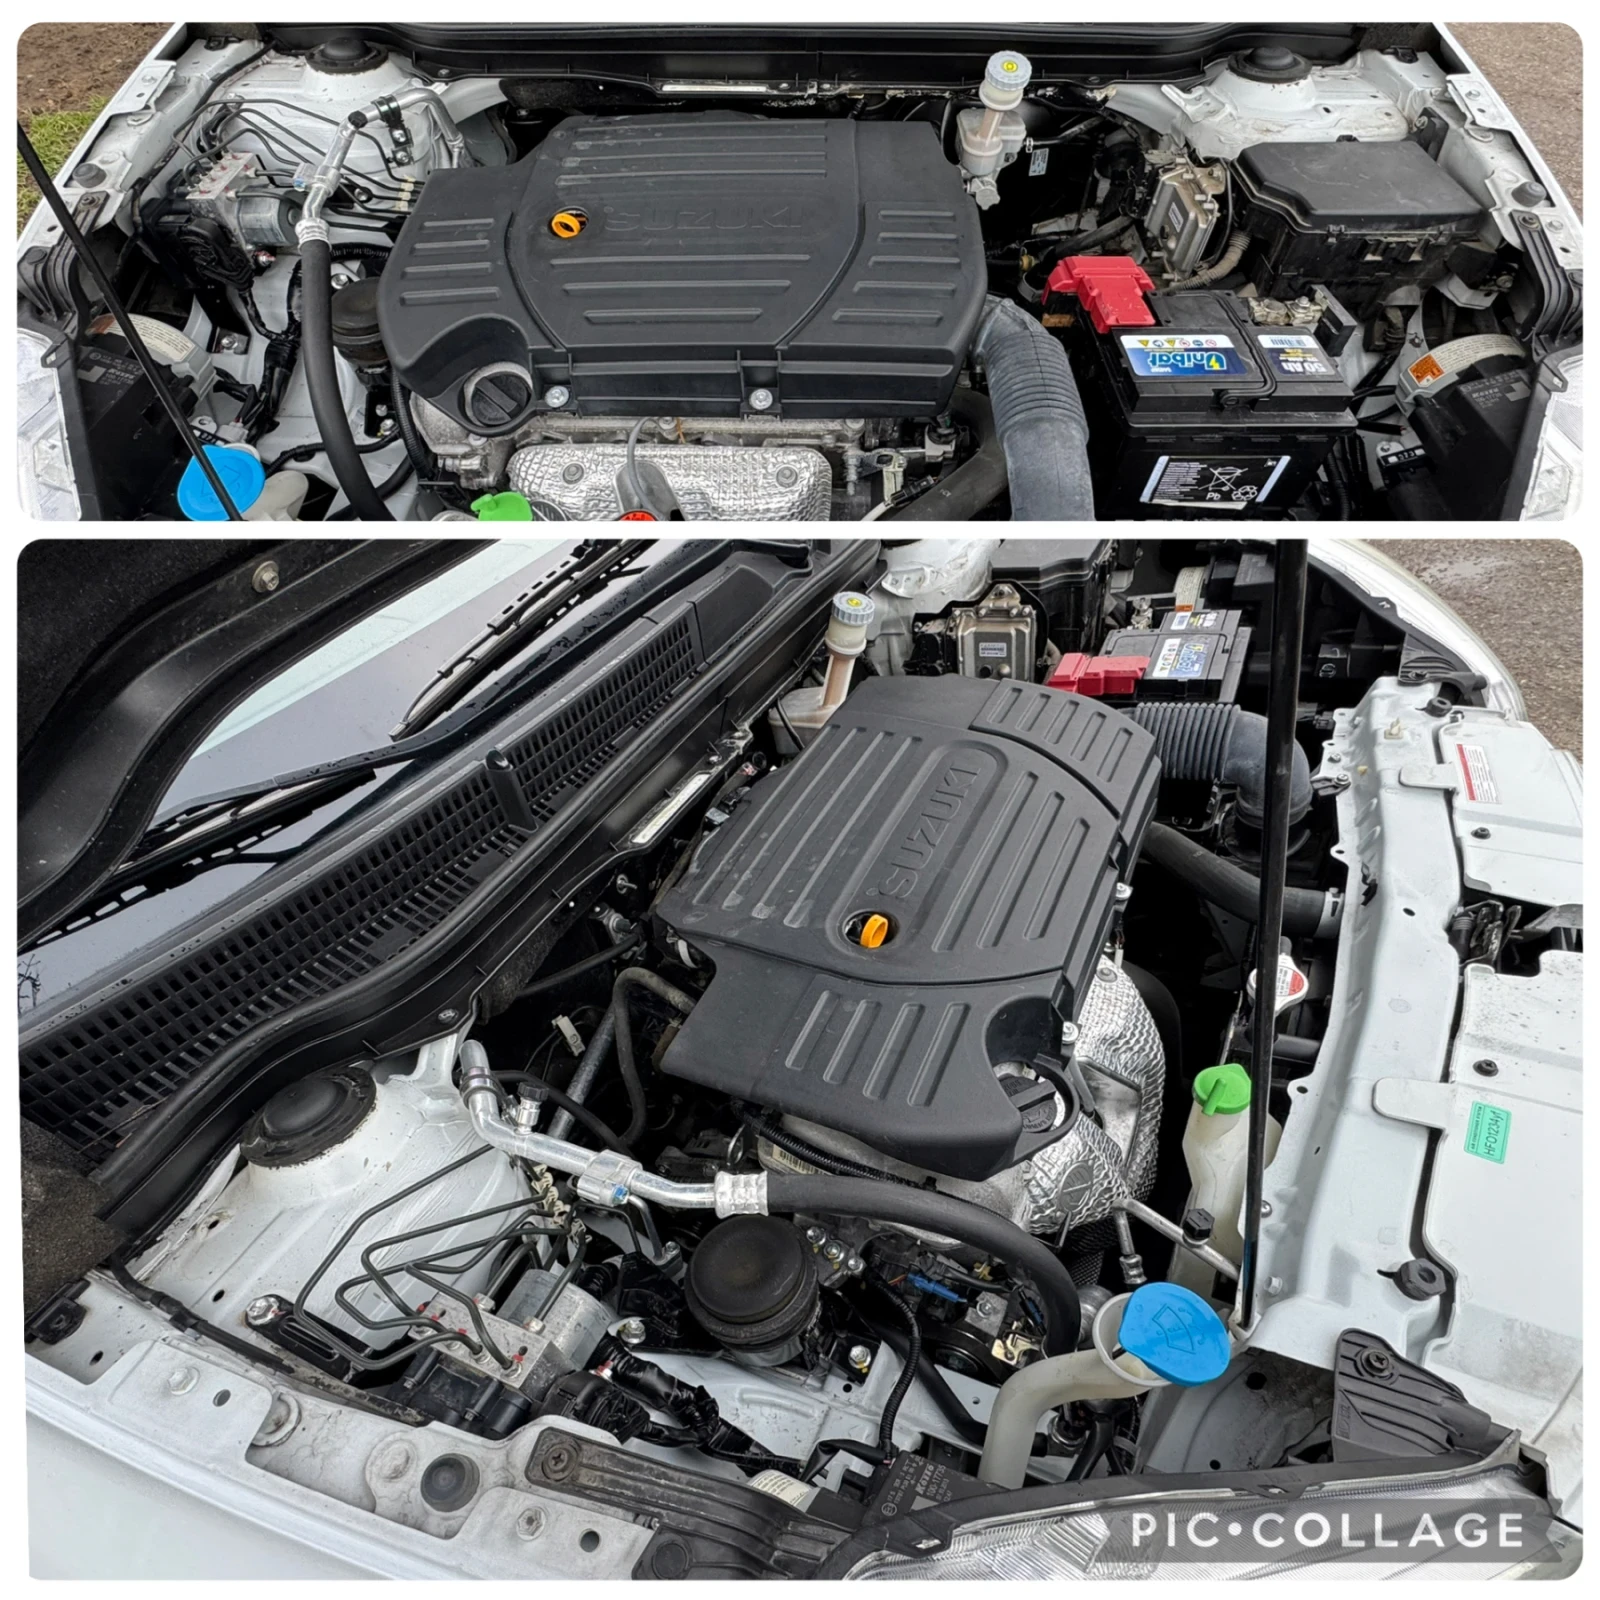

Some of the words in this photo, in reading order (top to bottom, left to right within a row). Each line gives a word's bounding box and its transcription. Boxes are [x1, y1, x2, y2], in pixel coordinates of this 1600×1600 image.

[604, 206, 802, 231] SUZUKI
[1147, 351, 1228, 371] Unibat
[1303, 362, 1327, 372] 50
[1206, 492, 1221, 500] Pb
[880, 766, 982, 899] SUZUKI
[1484, 1110, 1504, 1156] HFO1234yf
